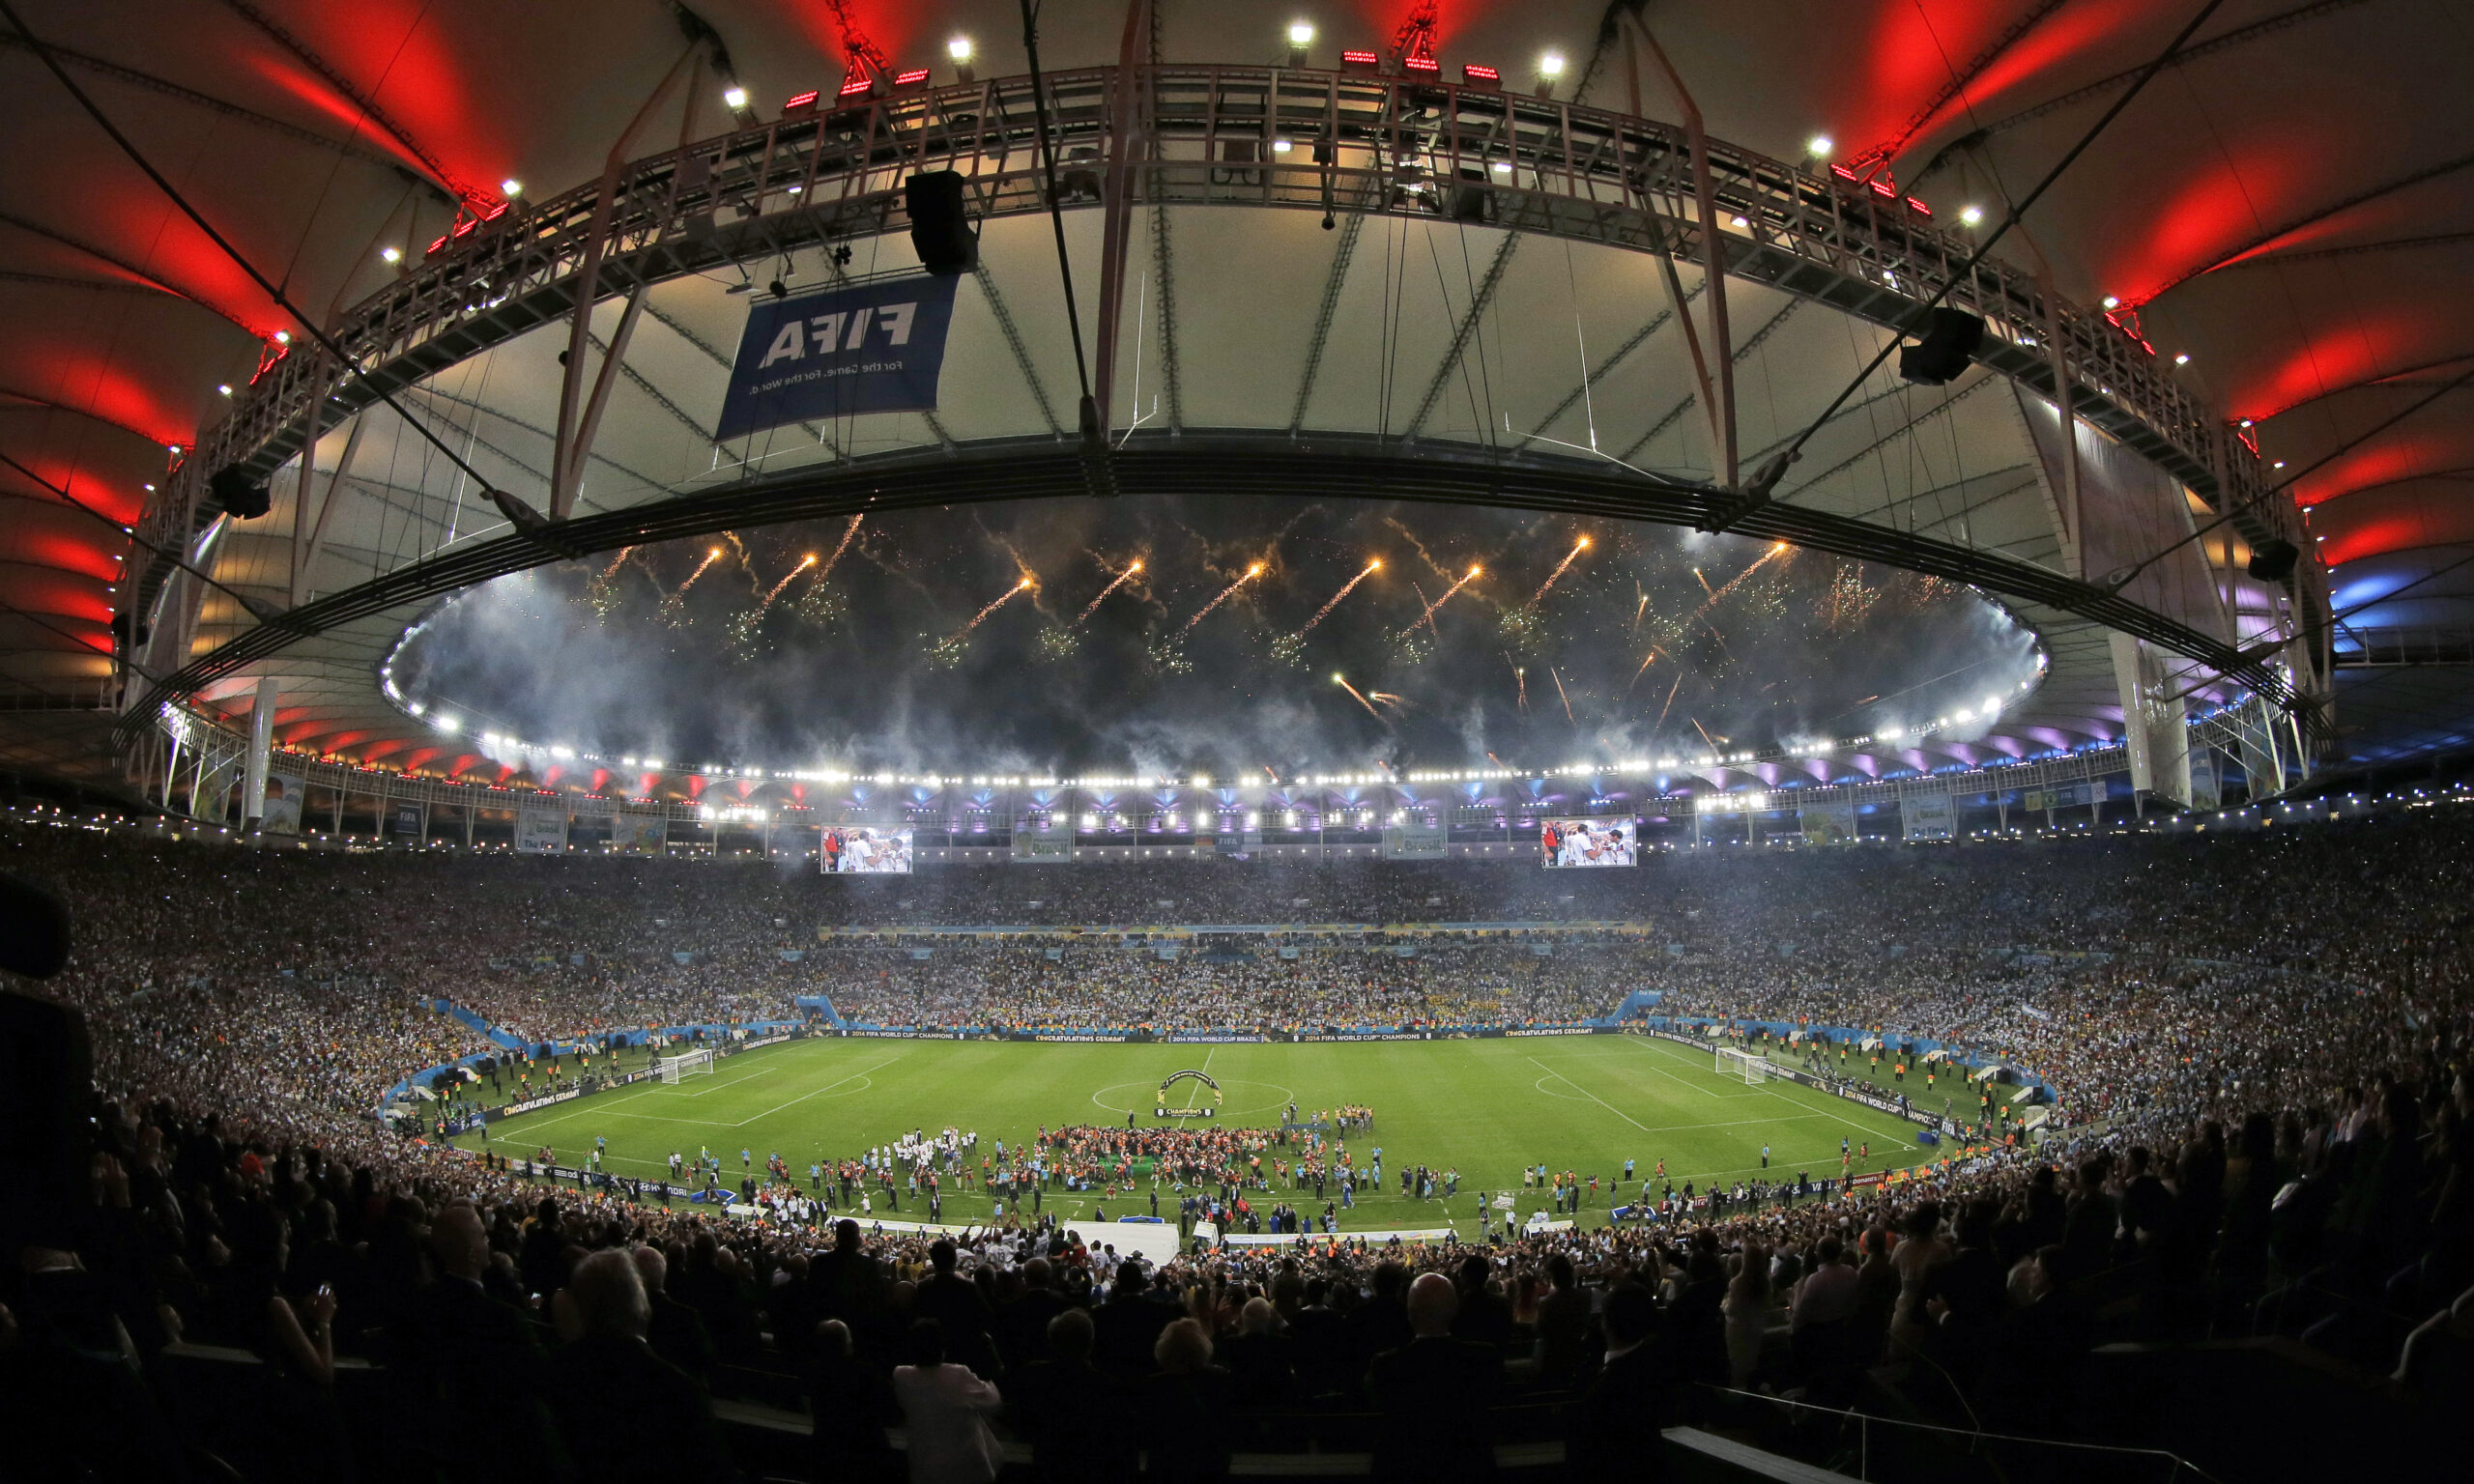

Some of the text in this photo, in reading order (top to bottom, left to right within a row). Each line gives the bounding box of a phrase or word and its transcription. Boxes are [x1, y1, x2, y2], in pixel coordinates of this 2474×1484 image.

[400, 812, 416, 822] FIFA
[503, 1088, 581, 1116] CONGRATULATIONS GERMANY
[1844, 1089, 1856, 1099] 2014
[1856, 1093, 1868, 1103] FIFA
[1867, 1097, 1887, 1110] WORLD
[1942, 1120, 1955, 1136] FIFA
[997, 1251, 1005, 1263] 13
[1096, 1256, 1101, 1268] 6
